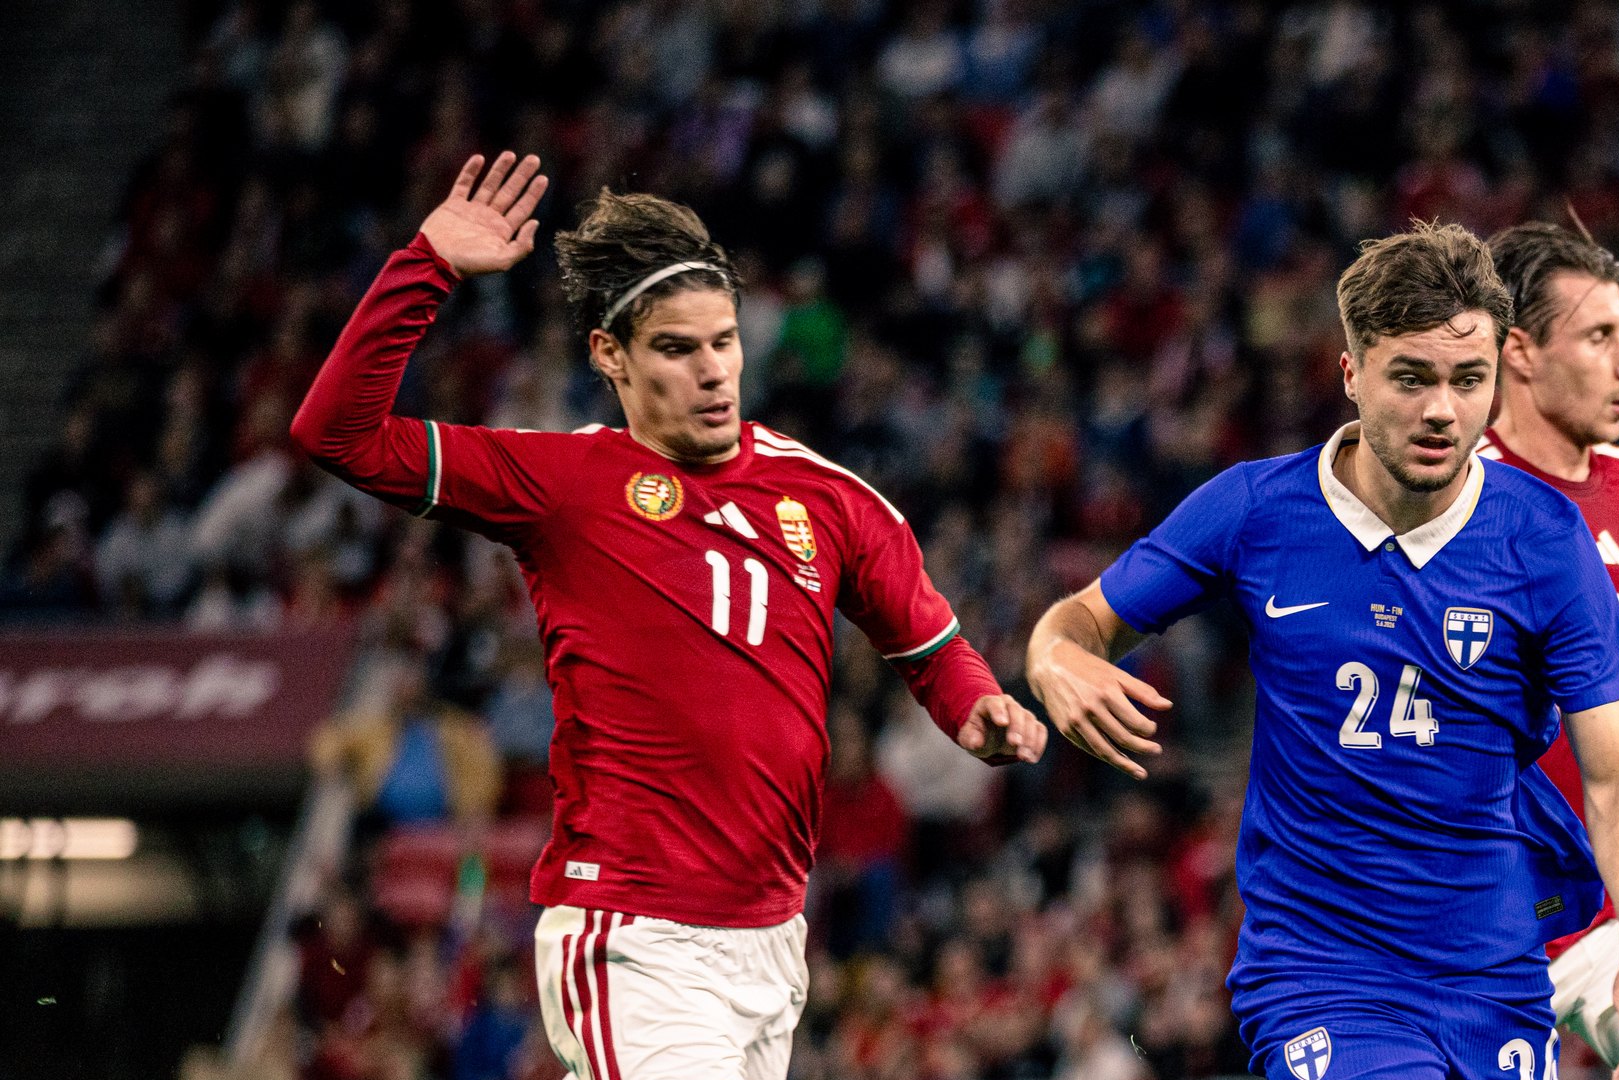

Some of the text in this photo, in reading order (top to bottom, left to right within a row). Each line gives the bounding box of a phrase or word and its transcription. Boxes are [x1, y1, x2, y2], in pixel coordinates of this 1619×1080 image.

[705, 549, 769, 646] 11
[1370, 603, 1386, 613] HUN
[1391, 606, 1403, 616] FIN
[1453, 613, 1486, 621] SUOMI
[1336, 661, 1440, 749] 24
[1292, 1032, 1322, 1051] SUOMI
